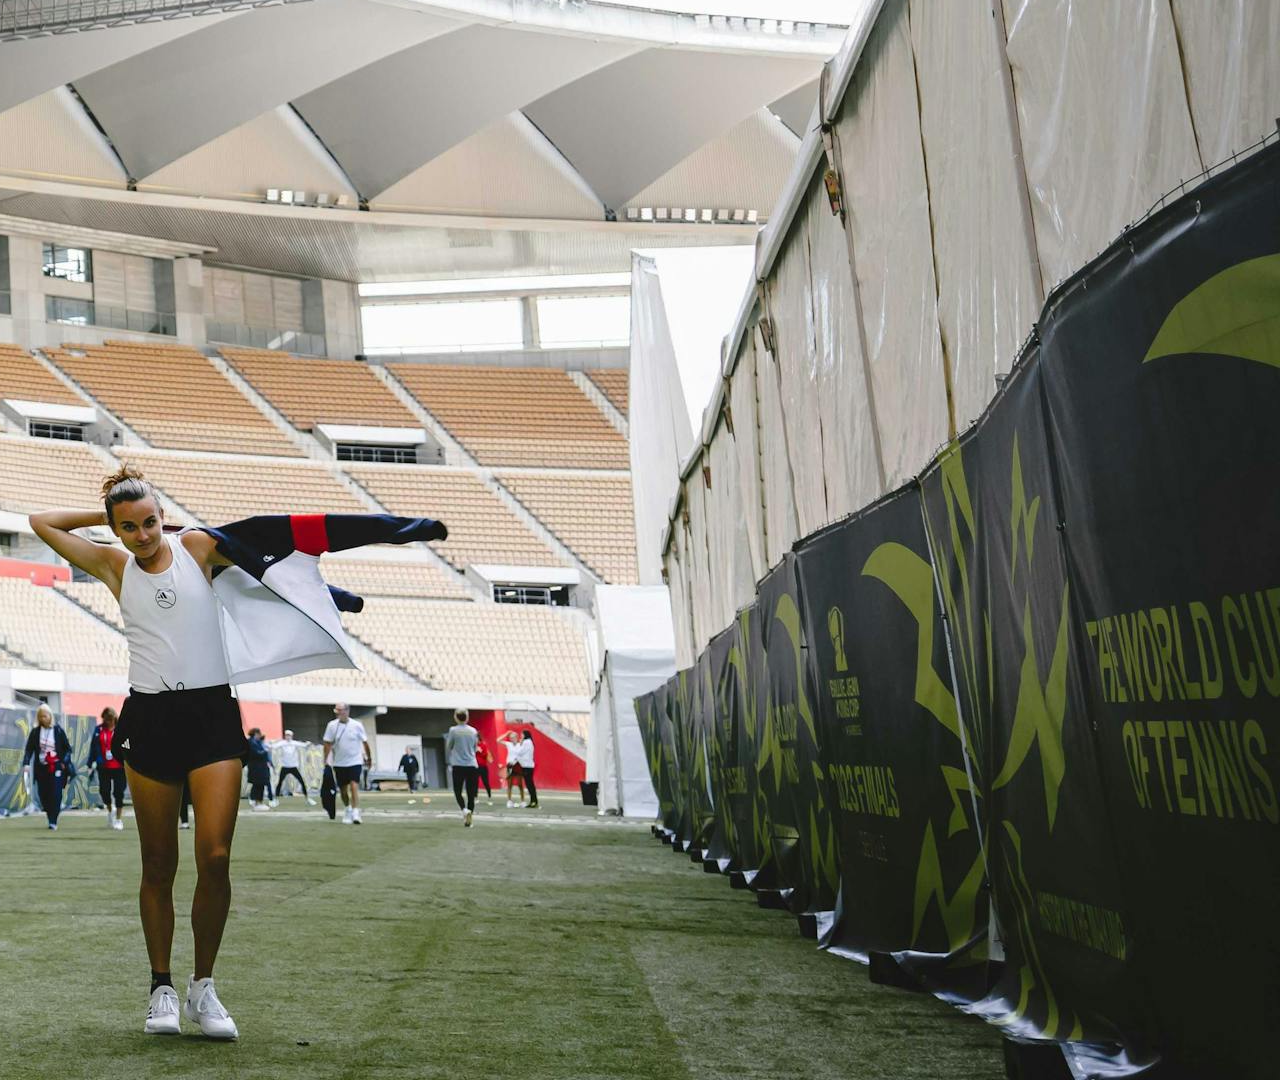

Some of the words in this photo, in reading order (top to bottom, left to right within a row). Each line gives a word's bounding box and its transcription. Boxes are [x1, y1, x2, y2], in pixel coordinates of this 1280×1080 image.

[1086, 616, 1128, 703] THE
[1114, 601, 1224, 703] WORLD
[854, 764, 900, 818] FINALS
[1122, 719, 1152, 809] OF
[1147, 719, 1280, 825] TENNIS
